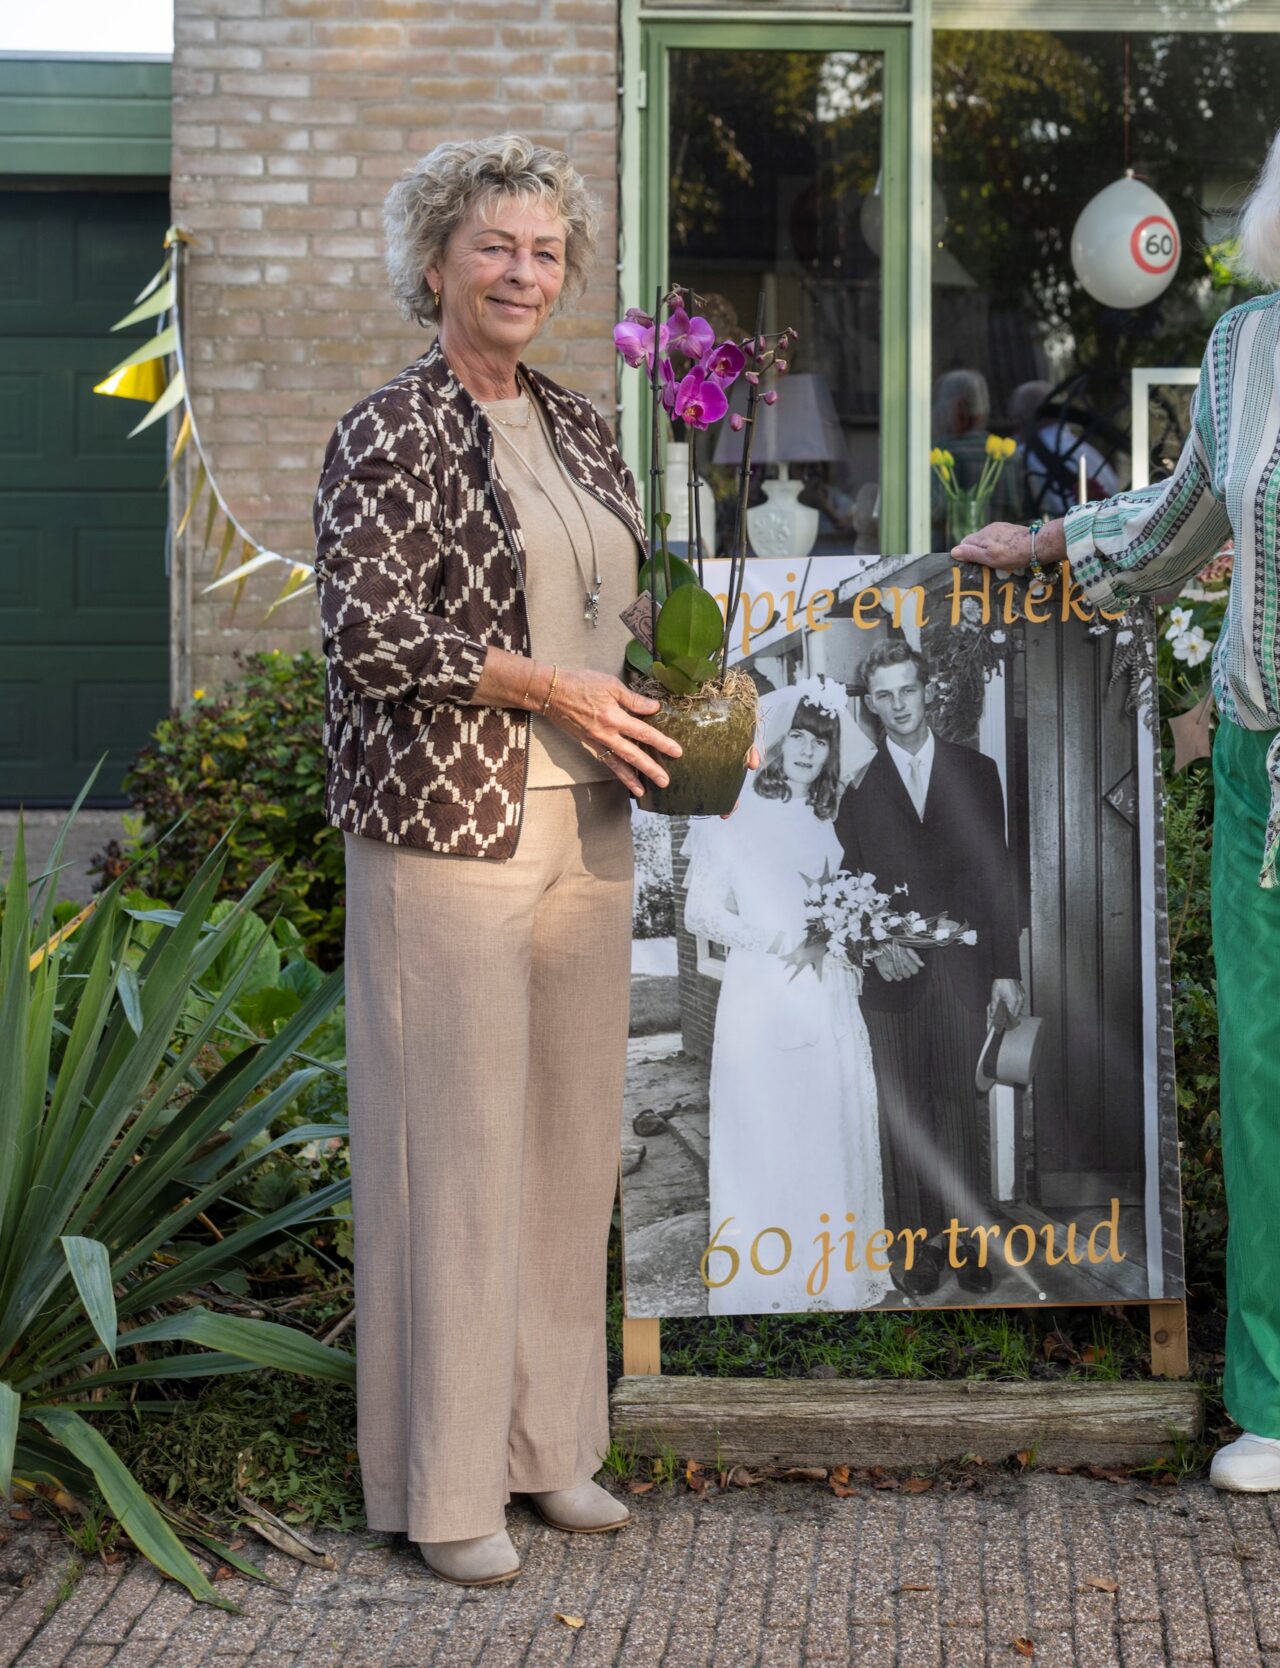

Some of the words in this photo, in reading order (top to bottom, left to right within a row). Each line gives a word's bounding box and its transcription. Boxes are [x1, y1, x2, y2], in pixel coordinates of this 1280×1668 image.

[1146, 234, 1173, 255] 60
[852, 585, 930, 630] en
[944, 559, 1127, 626] Hiek
[700, 1216, 792, 1288] 60
[806, 1212, 928, 1297] jier
[943, 1197, 1127, 1268] troud
